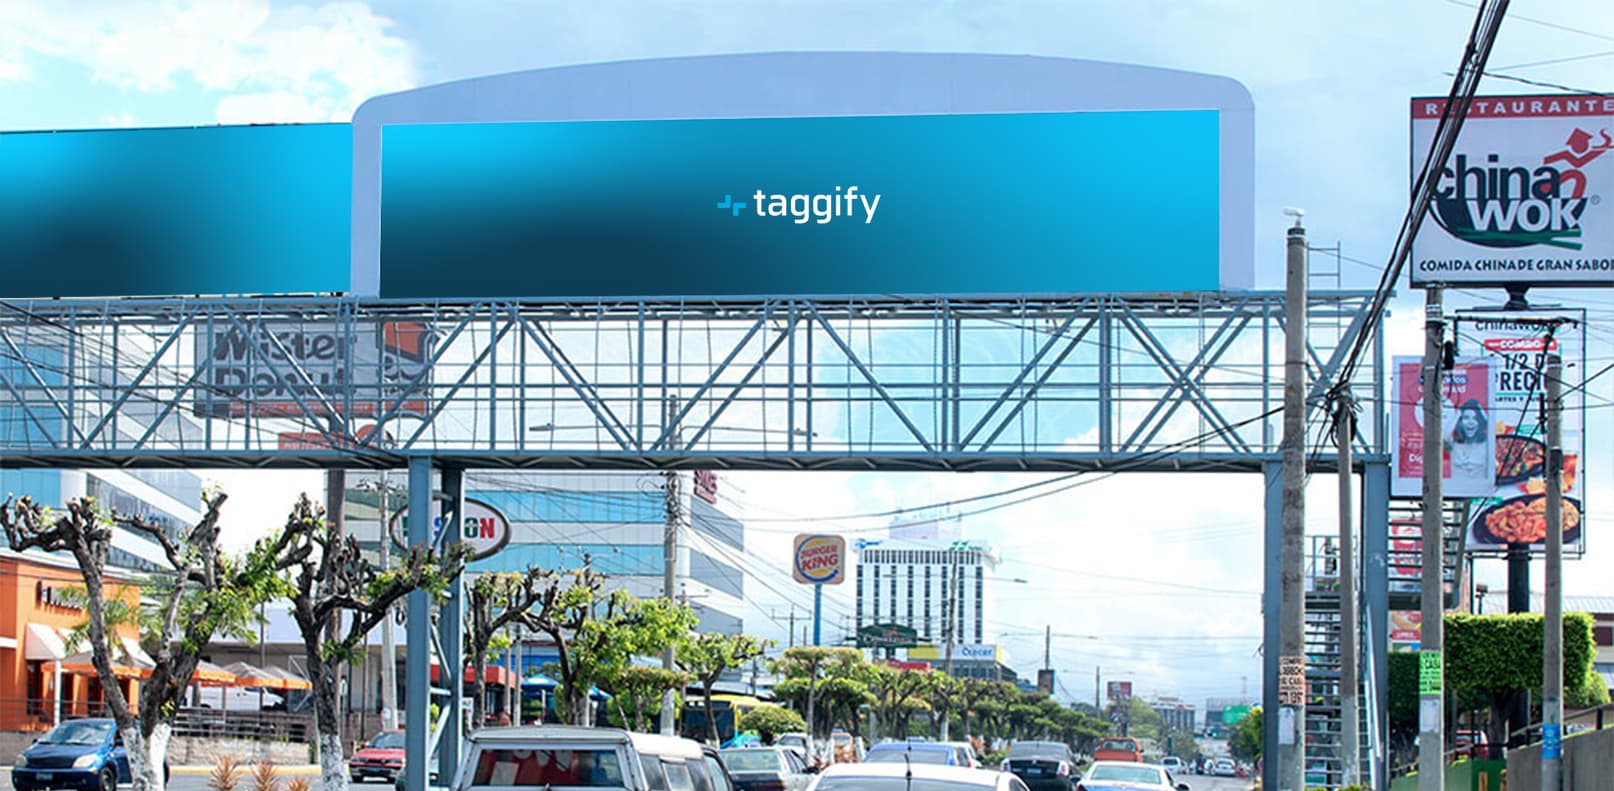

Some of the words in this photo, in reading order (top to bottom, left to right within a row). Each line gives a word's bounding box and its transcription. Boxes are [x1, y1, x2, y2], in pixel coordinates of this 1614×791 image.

[1425, 100, 1614, 115] RTAURANTE
[1432, 154, 1561, 200] china
[753, 185, 881, 224] taggify
[1419, 259, 1473, 272] COMIDA
[1536, 259, 1573, 271] GRAN
[214, 331, 358, 361] Mister
[1503, 353, 1528, 370] 1/2
[1495, 371, 1548, 391] RECI
[801, 554, 839, 572] KING
